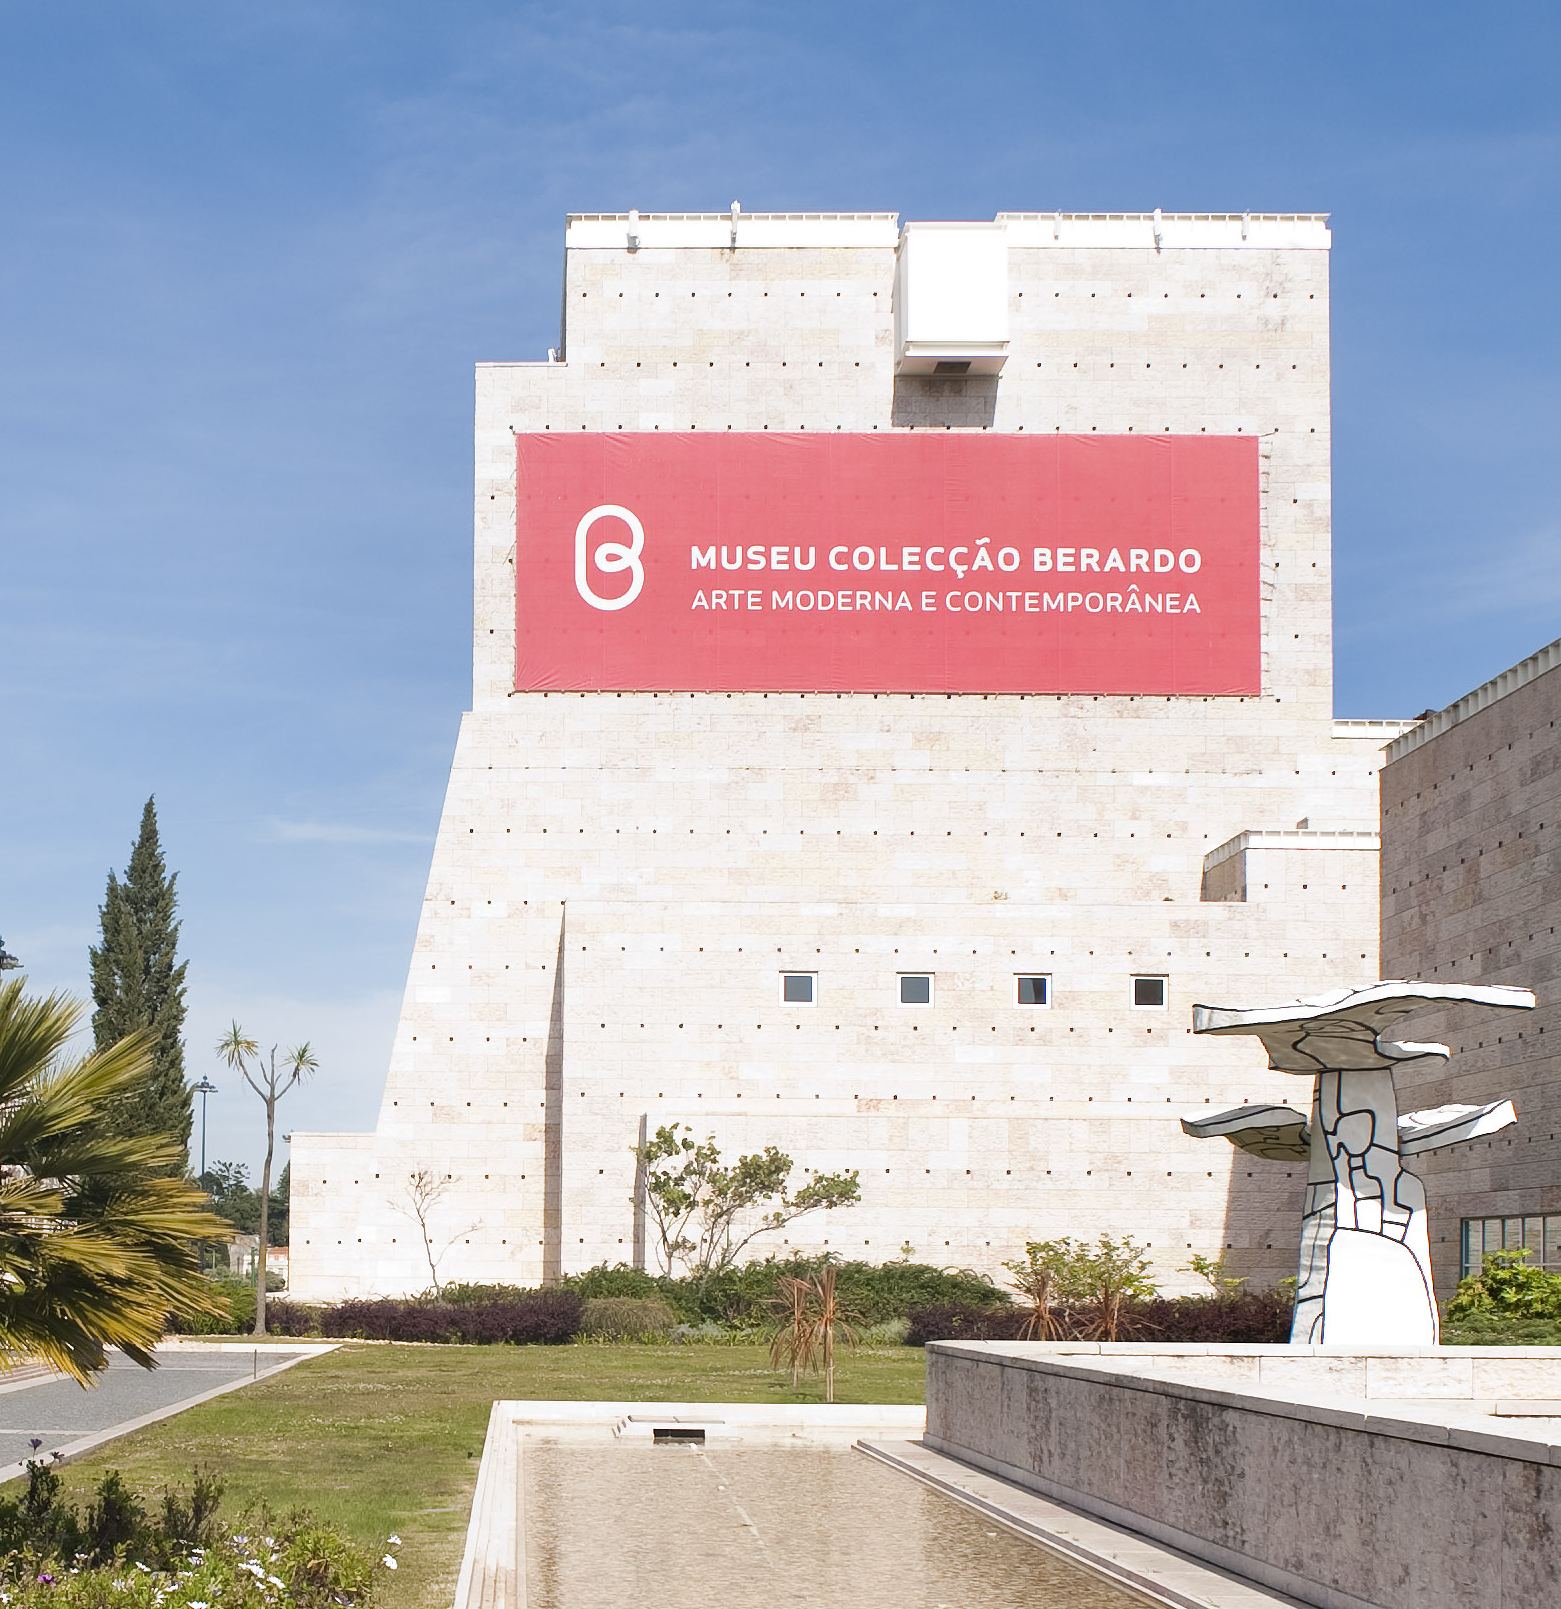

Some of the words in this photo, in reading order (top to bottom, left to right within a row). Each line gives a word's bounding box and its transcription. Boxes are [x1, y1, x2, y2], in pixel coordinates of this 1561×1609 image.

[690, 545, 816, 571] MUSEU
[828, 537, 1021, 579] COLECÇÃO
[1033, 547, 1202, 574] BERARDO
[690, 589, 763, 611] ARTE
[771, 590, 913, 612] MODERNA
[921, 591, 937, 612] E
[945, 584, 1202, 614] CONTEMPORÂNEA
